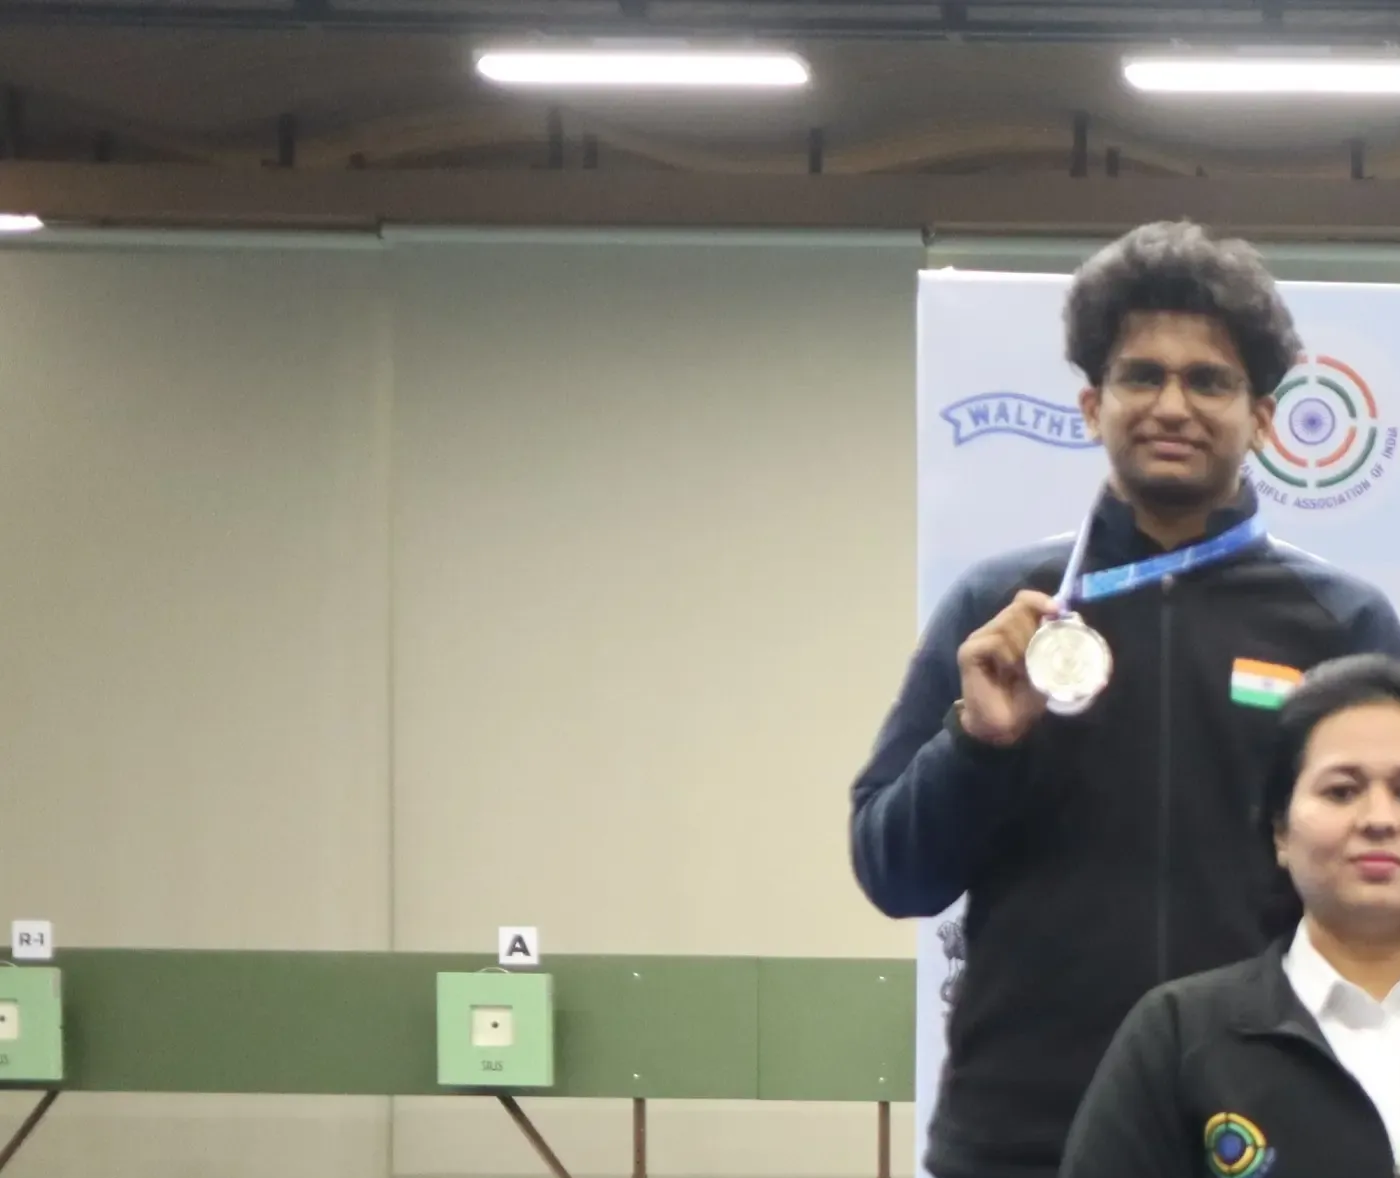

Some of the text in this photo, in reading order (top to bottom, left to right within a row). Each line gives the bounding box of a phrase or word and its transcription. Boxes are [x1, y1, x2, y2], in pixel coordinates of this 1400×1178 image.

[967, 400, 1084, 439] WALTHE
[1256, 427, 1398, 509] RIFLE ASSOCIATION OF INDIA
[18, 932, 44, 946] R-1
[506, 934, 531, 956] A
